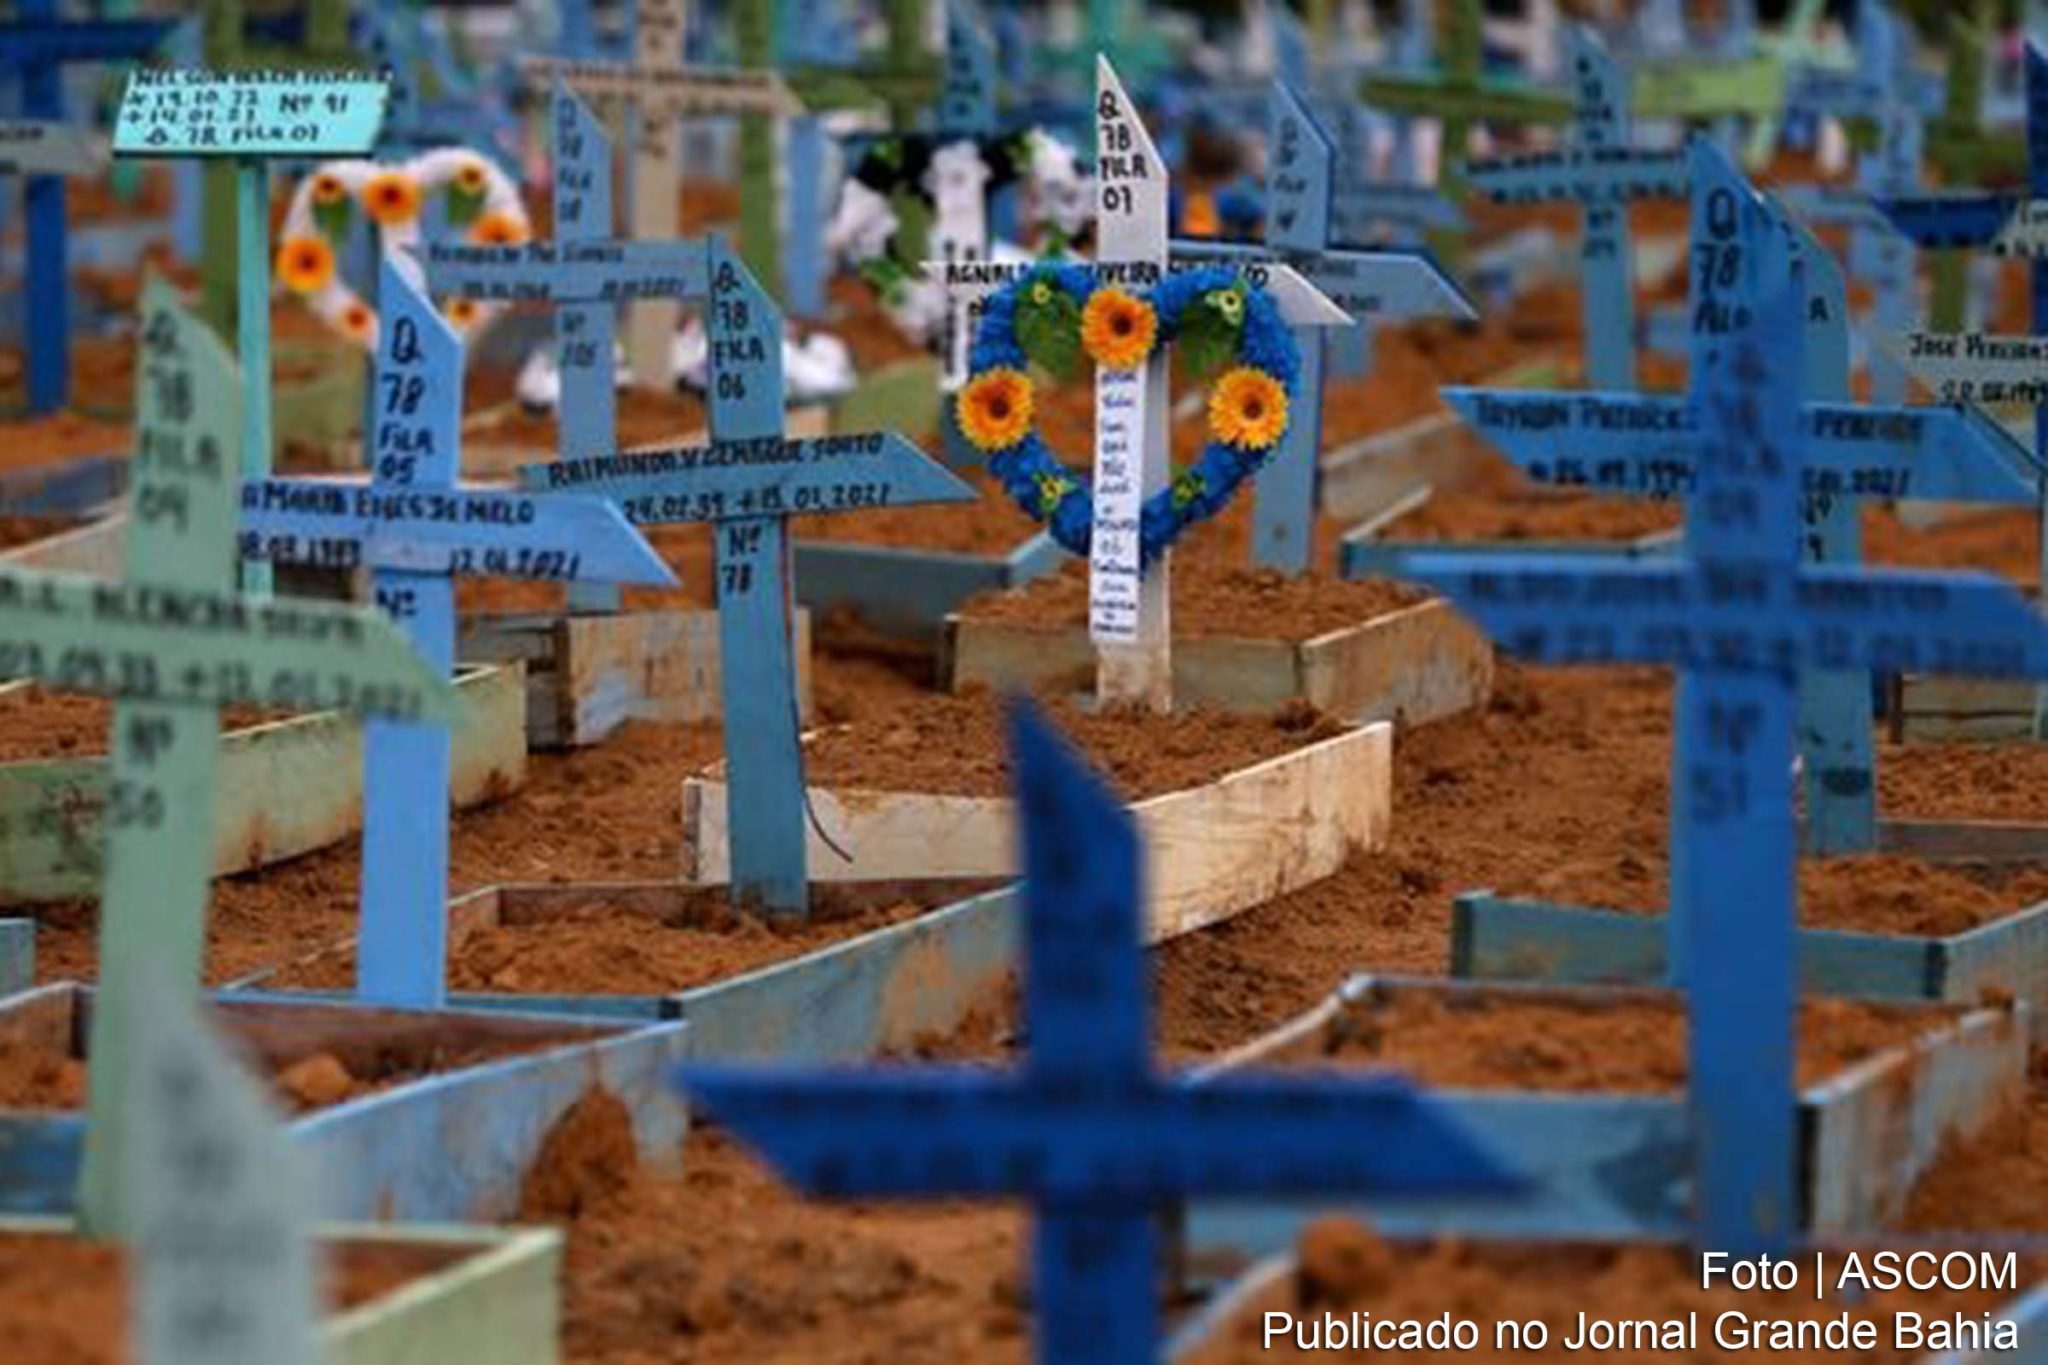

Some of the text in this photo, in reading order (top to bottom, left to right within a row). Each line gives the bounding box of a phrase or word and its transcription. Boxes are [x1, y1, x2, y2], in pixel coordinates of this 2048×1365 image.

[1098, 91, 1120, 120] Q
[1100, 124, 1132, 152] 78
[714, 260, 742, 294] Q
[718, 300, 749, 331] 78
[391, 314, 426, 366] Q
[380, 371, 426, 416] 78
[379, 419, 435, 456] FILA
[378, 453, 417, 485] 05
